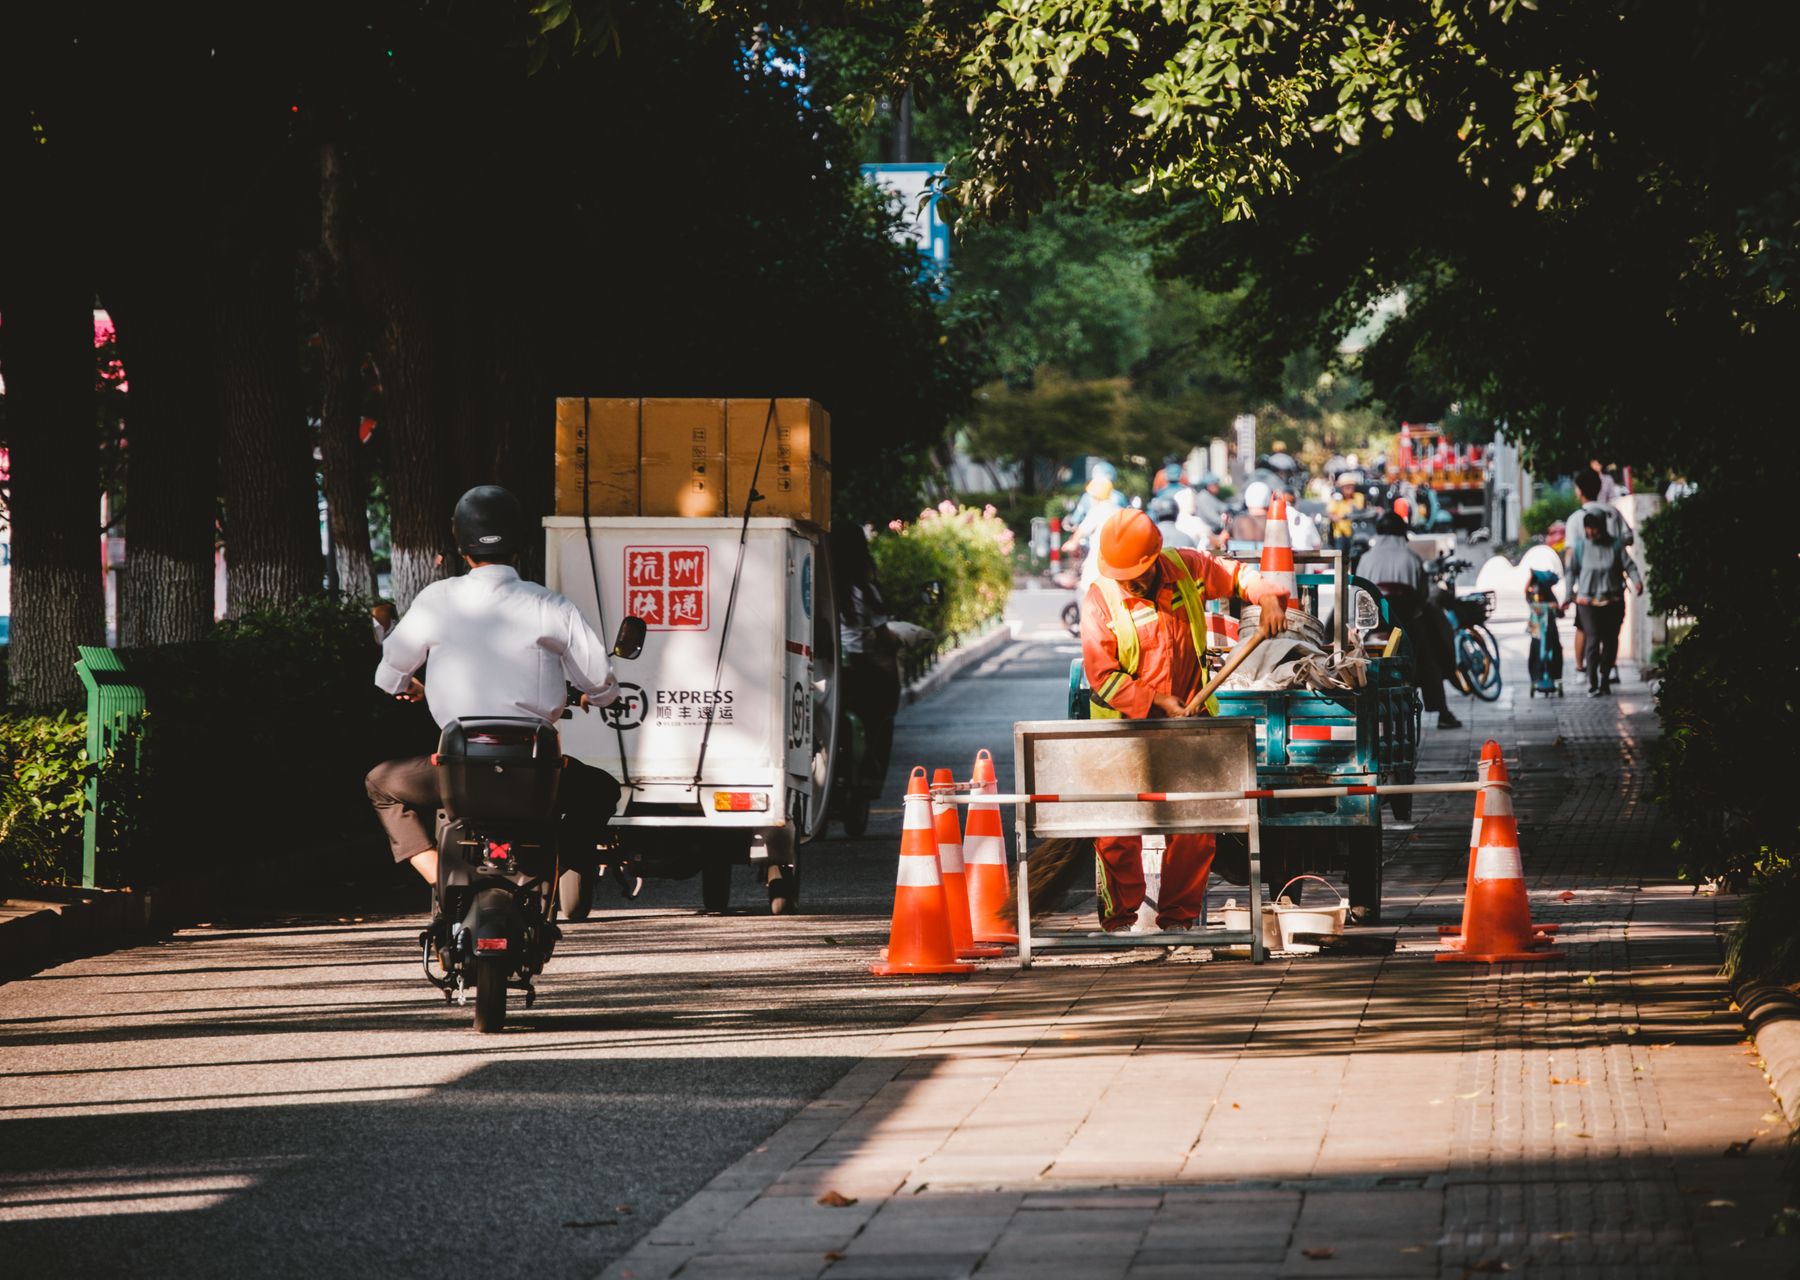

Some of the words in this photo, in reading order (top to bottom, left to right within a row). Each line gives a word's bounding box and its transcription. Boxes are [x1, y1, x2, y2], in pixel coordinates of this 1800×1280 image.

[632, 554, 700, 584] 杭州
[632, 592, 701, 621] 快递
[656, 690, 734, 704] EXPRESS
